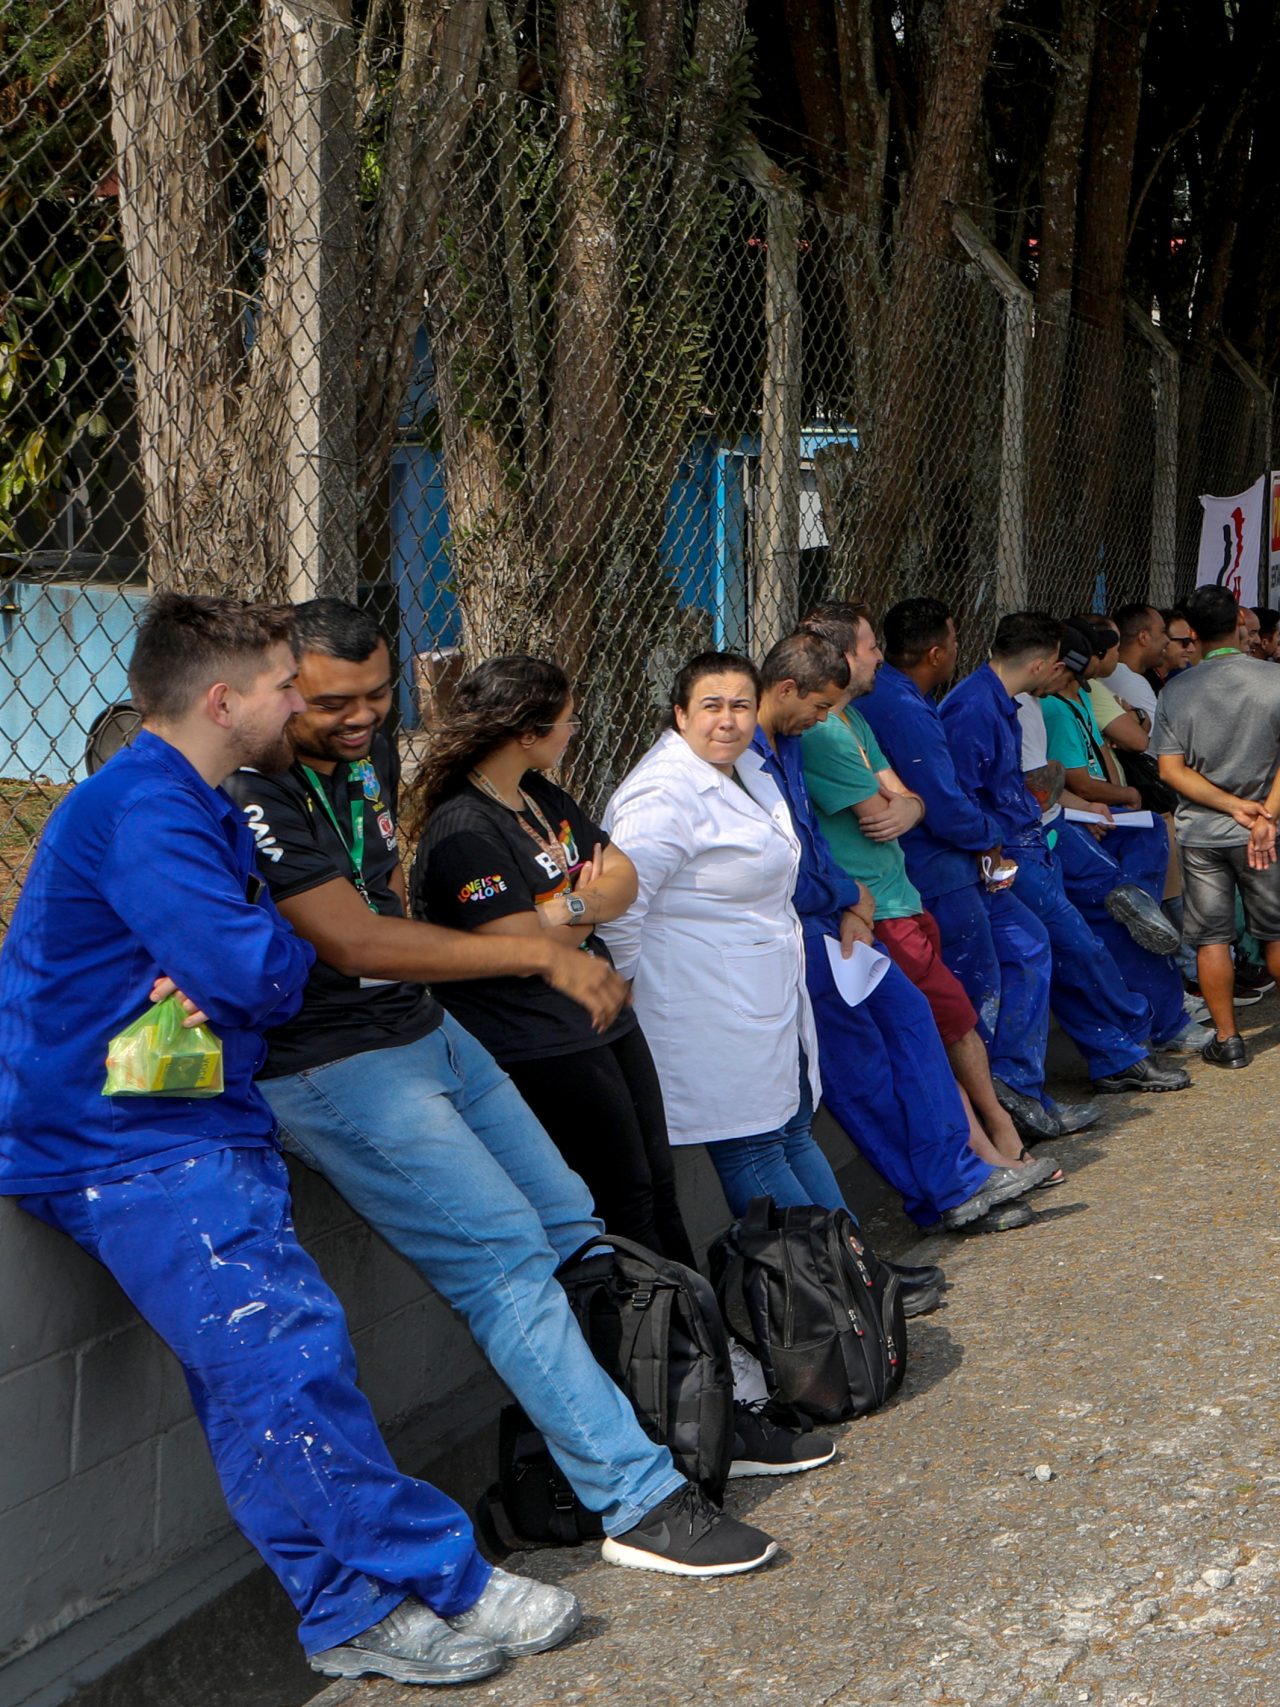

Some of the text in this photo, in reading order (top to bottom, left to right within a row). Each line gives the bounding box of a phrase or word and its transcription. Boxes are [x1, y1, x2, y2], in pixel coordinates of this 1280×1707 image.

[457, 876, 492, 903] LOVE IS
[478, 881, 508, 900] LOVE
